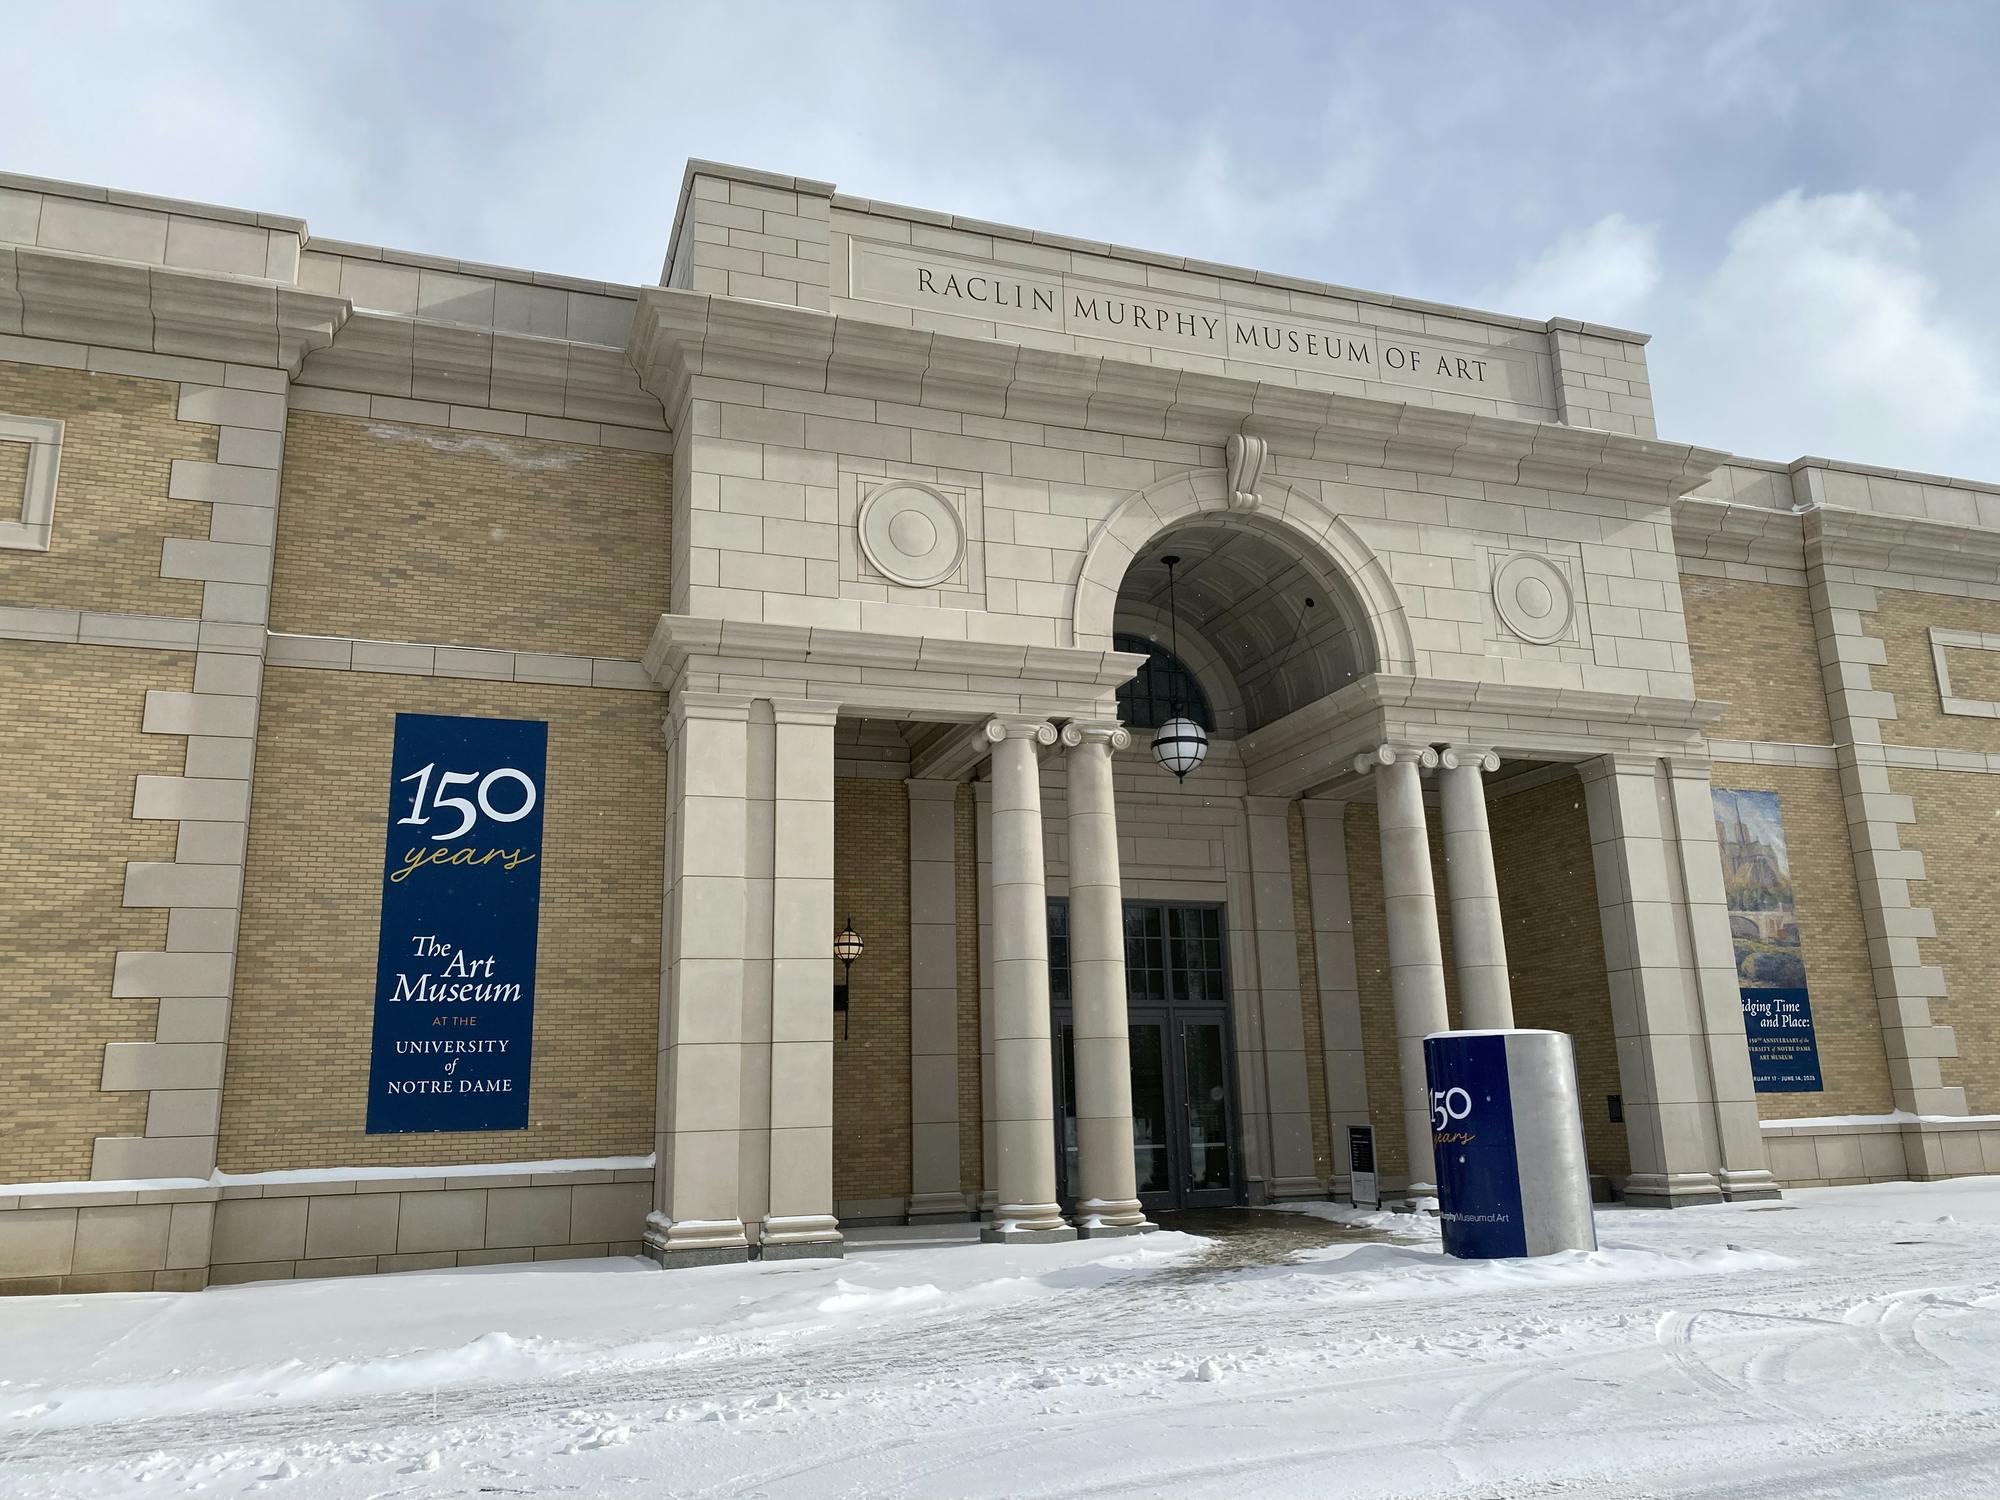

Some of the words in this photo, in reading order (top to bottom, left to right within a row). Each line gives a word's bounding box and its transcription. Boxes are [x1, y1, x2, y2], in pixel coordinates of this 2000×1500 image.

[917, 268, 1053, 313] RACLIN
[1074, 295, 1219, 339] MURPHY
[1236, 323, 1371, 364] MUSEUM
[1386, 347, 1420, 371] OF
[1437, 355, 1487, 382] ART
[397, 762, 537, 841] 150
[390, 843, 535, 882] years
[412, 935, 452, 958] The
[441, 949, 496, 979] Art
[389, 973, 522, 1003] Museum
[1742, 998, 1772, 1016] idging
[1773, 999, 1800, 1012] Time
[432, 1016, 450, 1026] AT
[452, 1016, 477, 1026] THE
[1760, 1014, 1779, 1027] and
[1781, 1014, 1810, 1028] Place:
[395, 1039, 510, 1054] UNIVERSITY
[444, 1058, 461, 1074] of
[388, 1079, 453, 1095] NOTRE
[459, 1078, 513, 1093] DAME
[1429, 1087, 1472, 1131] 150
[1455, 1212, 1487, 1222] Museum
[1496, 1212, 1510, 1223] Art
